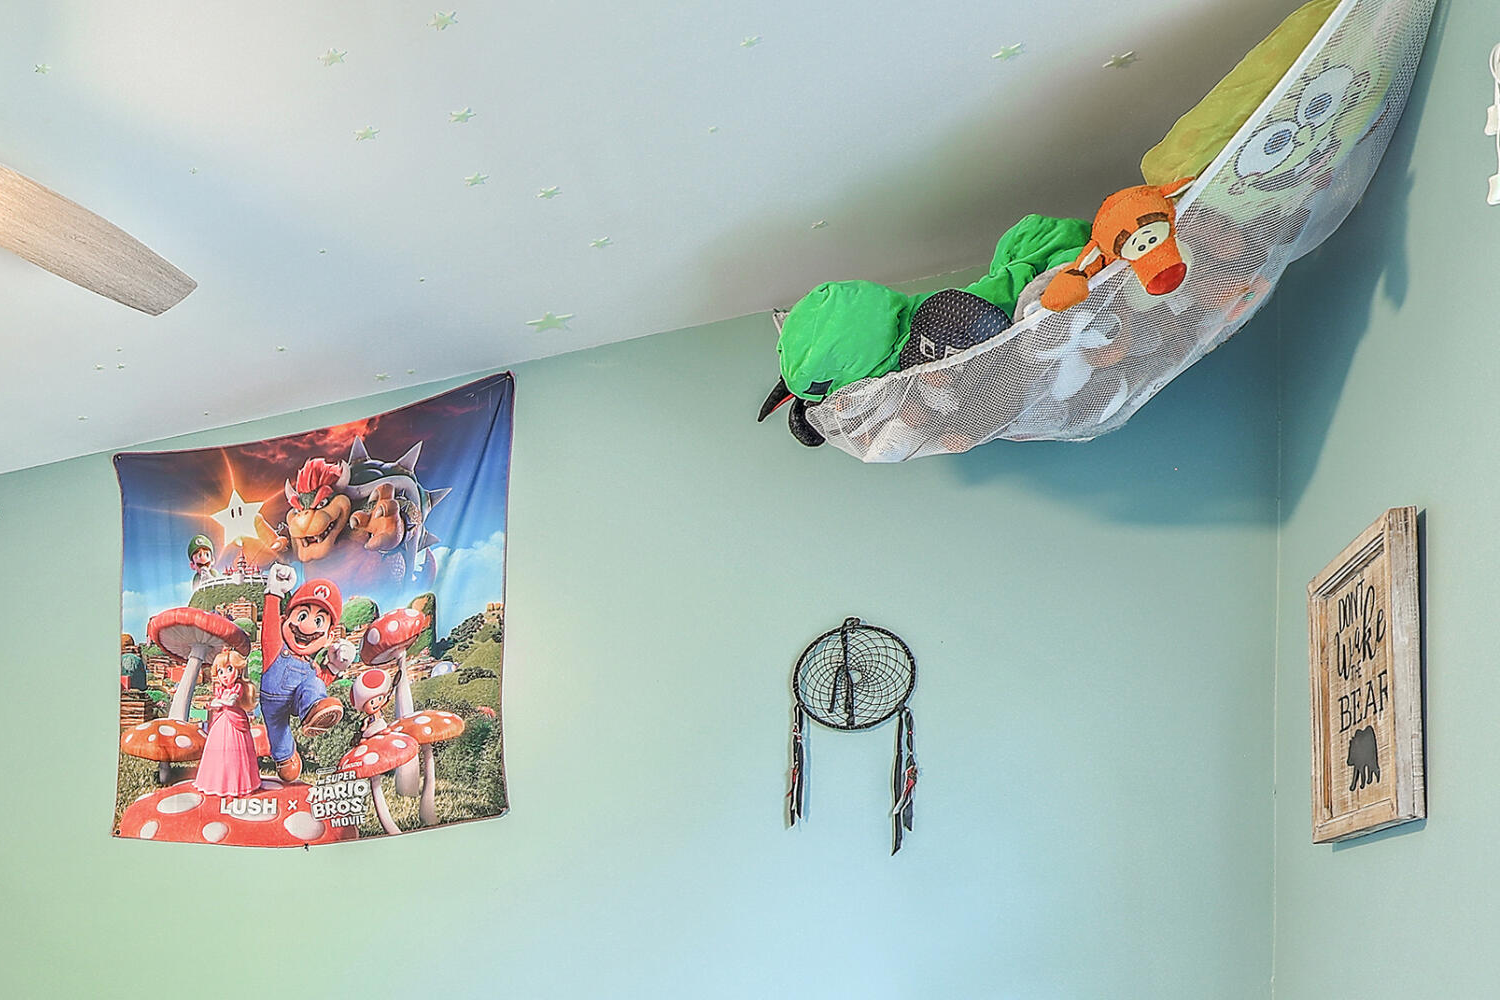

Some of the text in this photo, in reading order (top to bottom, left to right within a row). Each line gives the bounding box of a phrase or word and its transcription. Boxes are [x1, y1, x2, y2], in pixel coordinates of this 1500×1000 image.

[314, 585, 328, 598] M
[325, 770, 357, 784] SUPER
[305, 780, 370, 804] MARIO
[220, 797, 277, 815] LUSH
[331, 814, 366, 828] MOVIE
